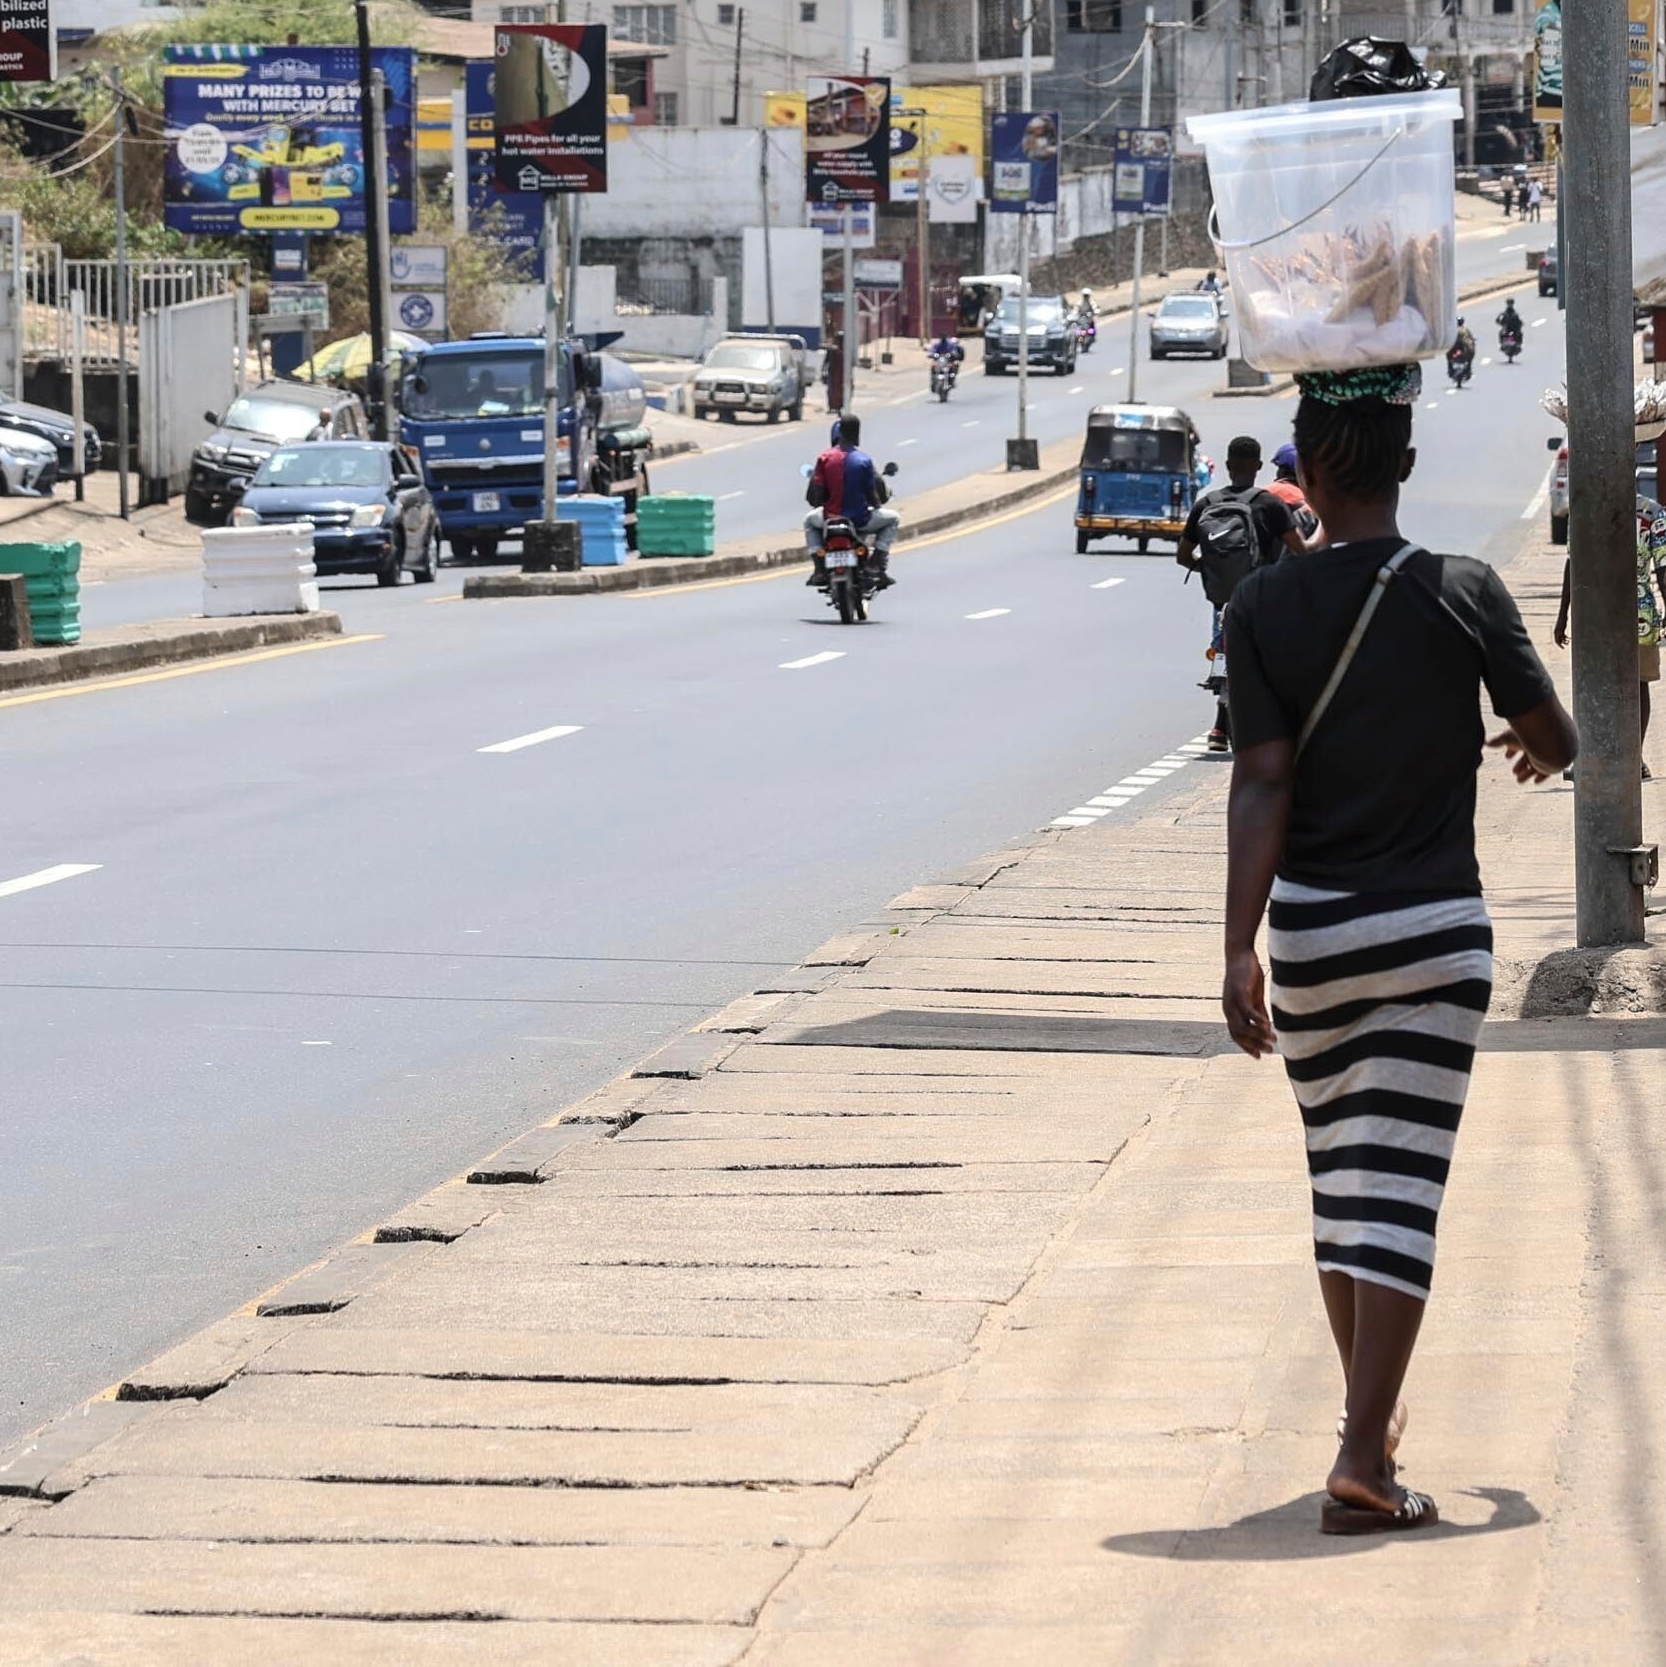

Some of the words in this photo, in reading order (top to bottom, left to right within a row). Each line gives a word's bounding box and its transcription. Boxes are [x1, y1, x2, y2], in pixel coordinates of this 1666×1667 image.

[2, 16, 47, 33] plastic
[198, 84, 245, 98] MANY
[248, 83, 302, 98] PRIZES
[305, 85, 325, 98] TO
[223, 99, 258, 113] WITH
[525, 134, 550, 144] Pipes
[551, 134, 565, 142] for
[579, 135, 601, 144] your
